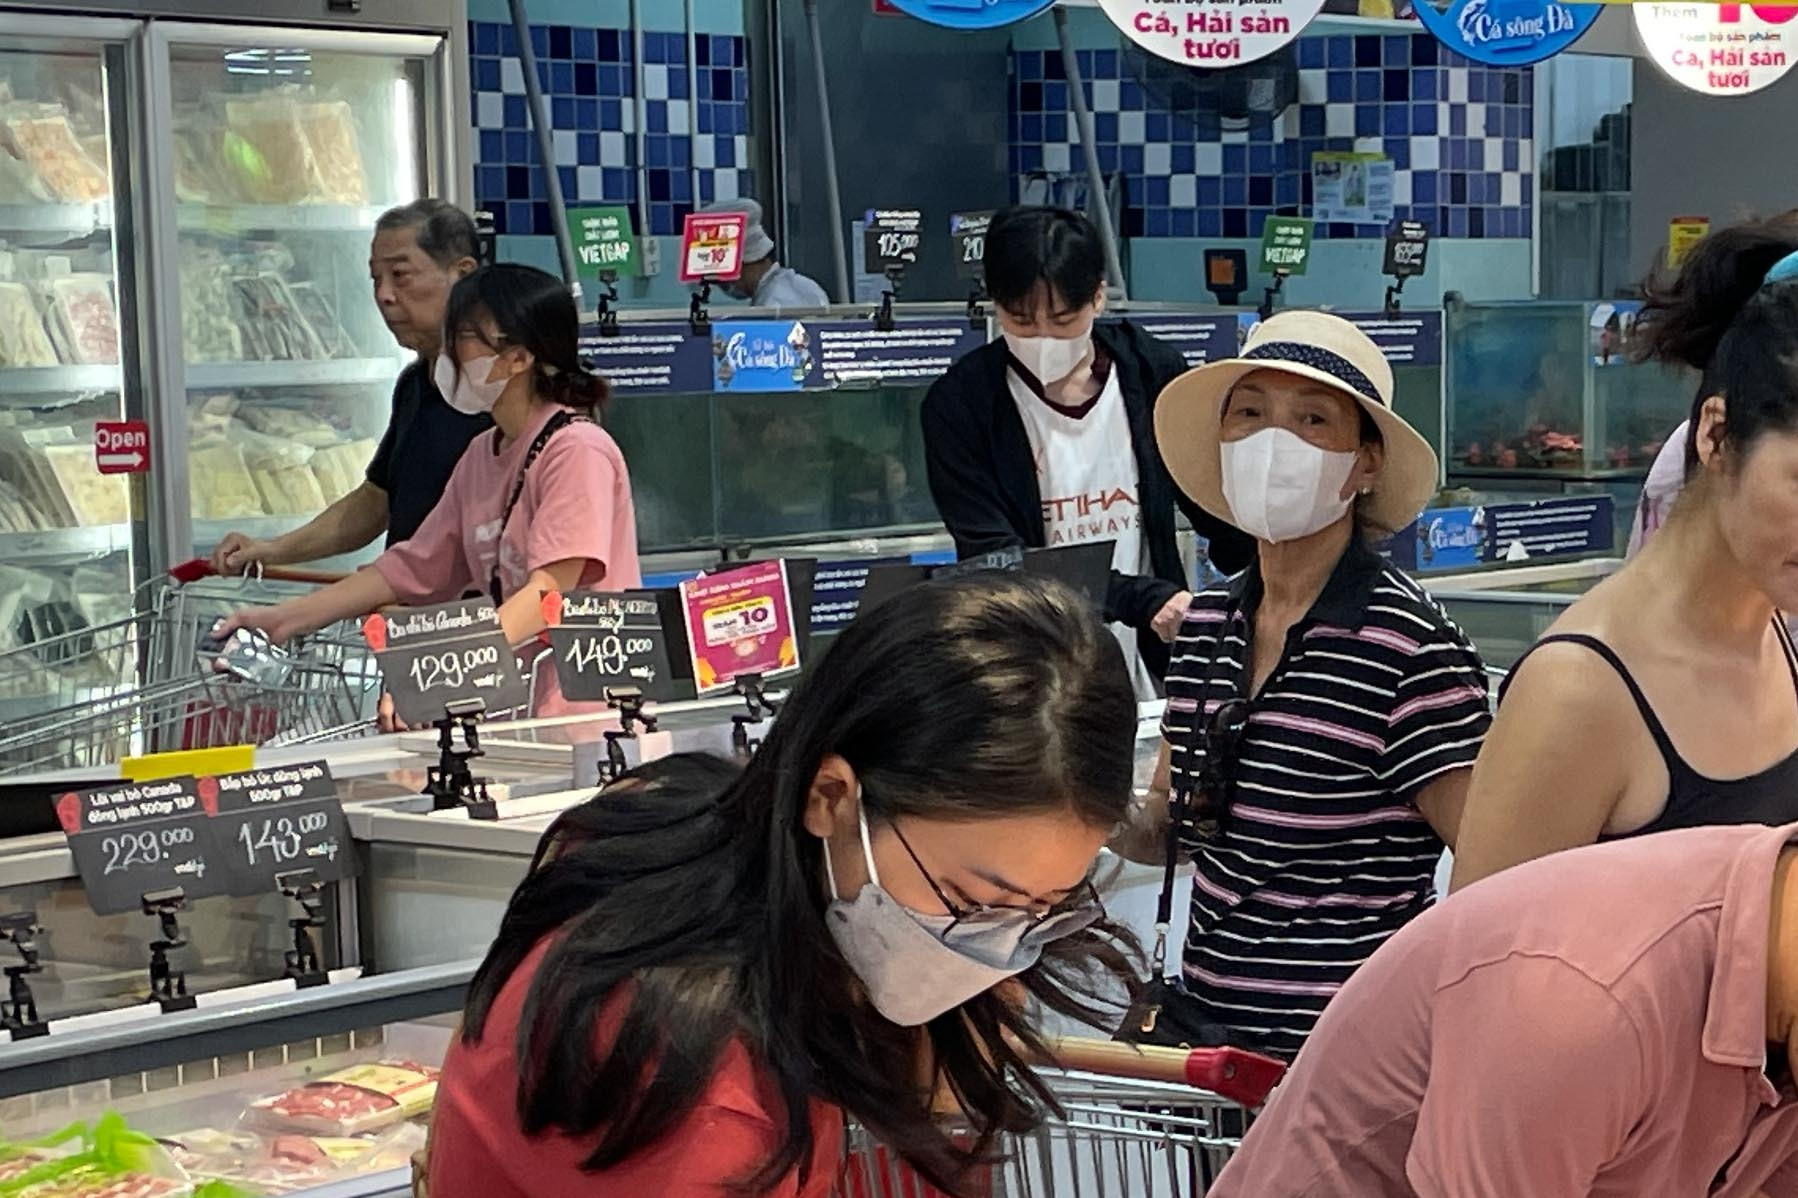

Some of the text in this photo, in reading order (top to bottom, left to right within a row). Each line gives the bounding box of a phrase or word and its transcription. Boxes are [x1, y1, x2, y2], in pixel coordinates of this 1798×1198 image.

[1134, 9, 1290, 37] Cá, Hải sản
[1476, 4, 1574, 41] Cá sông Đà
[1184, 38, 1240, 59] tươi
[1750, 46, 1786, 66] sản
[1708, 70, 1750, 88] tươi
[96, 428, 146, 452] Open
[564, 635, 653, 674] 149.000
[409, 646, 498, 692] 129.000
